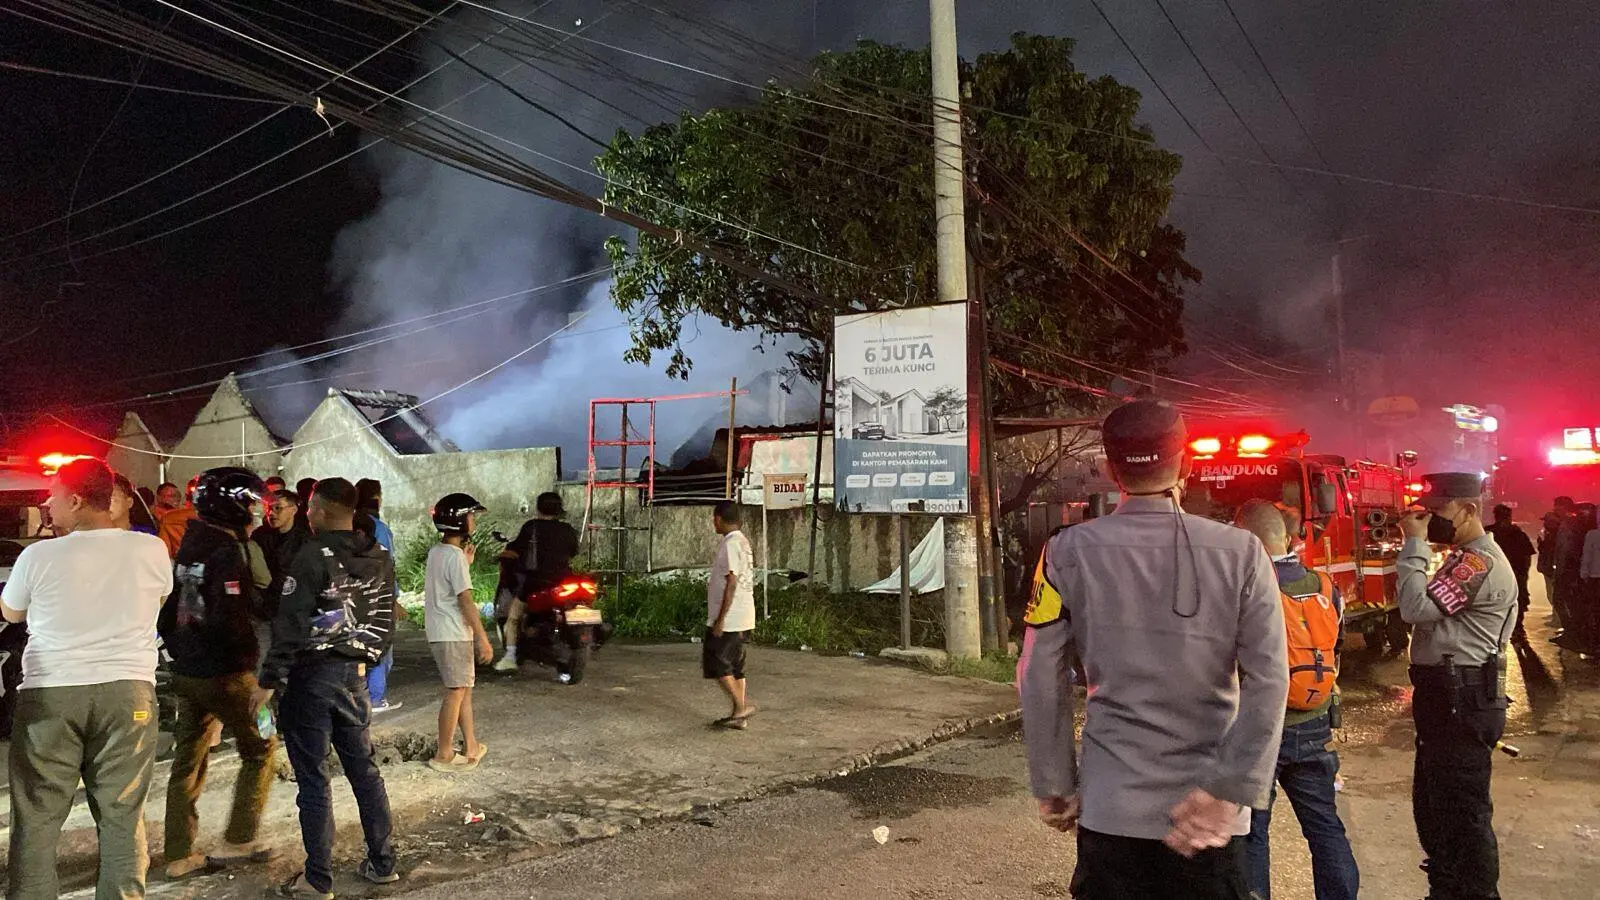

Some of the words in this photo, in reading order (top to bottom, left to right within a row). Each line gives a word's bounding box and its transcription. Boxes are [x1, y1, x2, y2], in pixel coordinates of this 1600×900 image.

[864, 346, 877, 363] 6
[880, 342, 934, 362] JUTA
[863, 364, 901, 376] TERIMA
[902, 362, 936, 373] KUNCI
[930, 458, 948, 466] KAMI
[1200, 463, 1278, 476] BANDUNG
[773, 483, 805, 493] BIDAN
